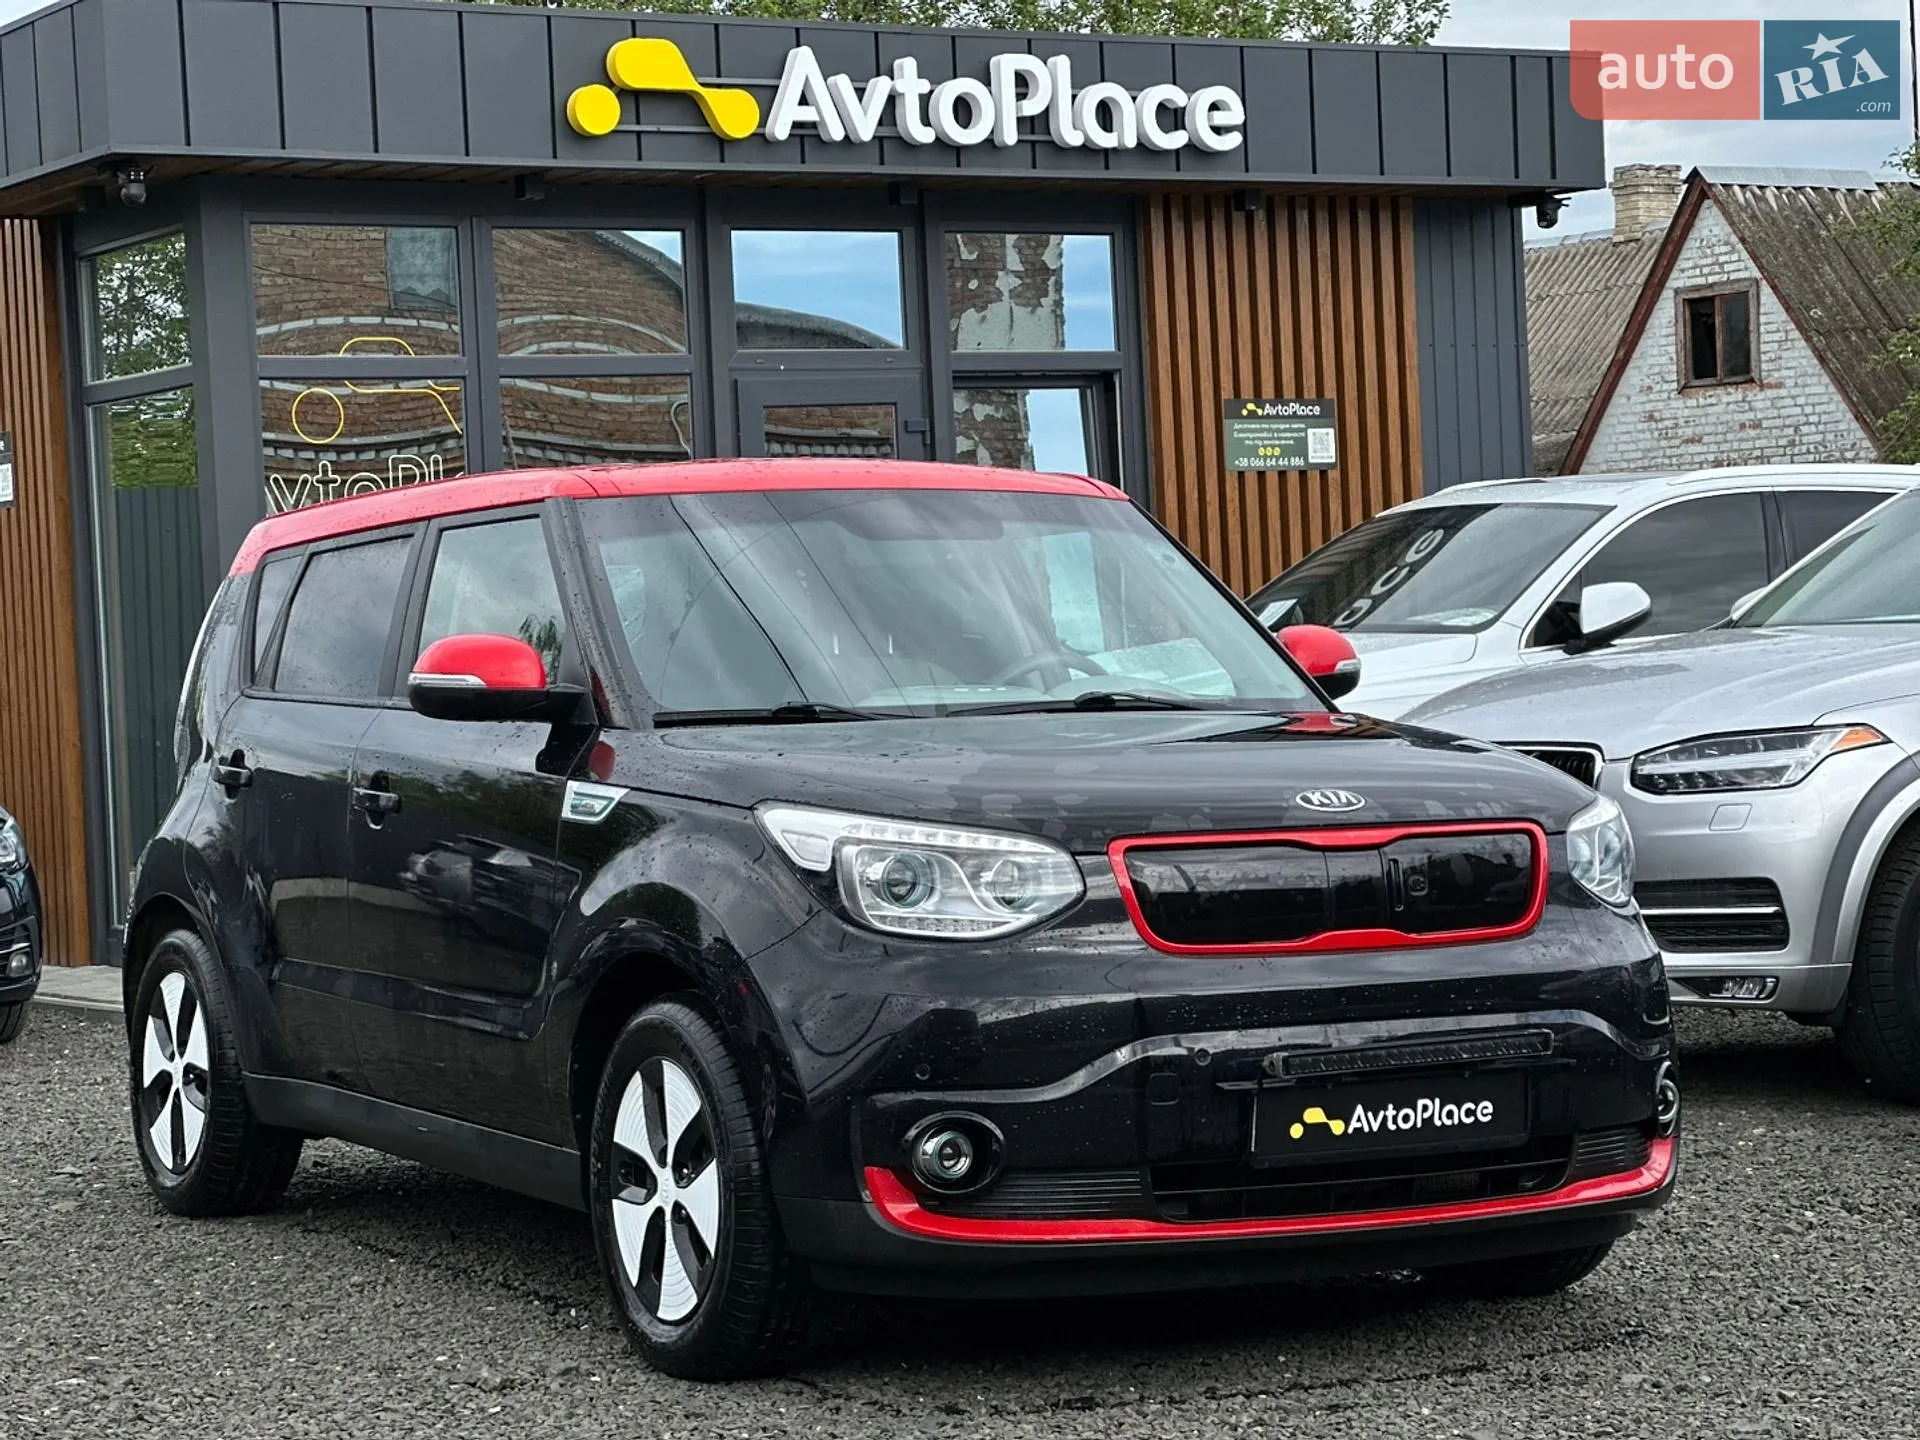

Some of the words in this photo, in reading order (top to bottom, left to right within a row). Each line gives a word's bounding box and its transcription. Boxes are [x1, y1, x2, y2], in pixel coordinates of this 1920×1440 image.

[765, 45, 1246, 152] AvtoPlace
[1263, 402, 1321, 416] AvtoPlace
[1278, 457, 1288, 466] 44
[1302, 789, 1361, 806] KIA
[1347, 1097, 1494, 1134] AvtoPlace
